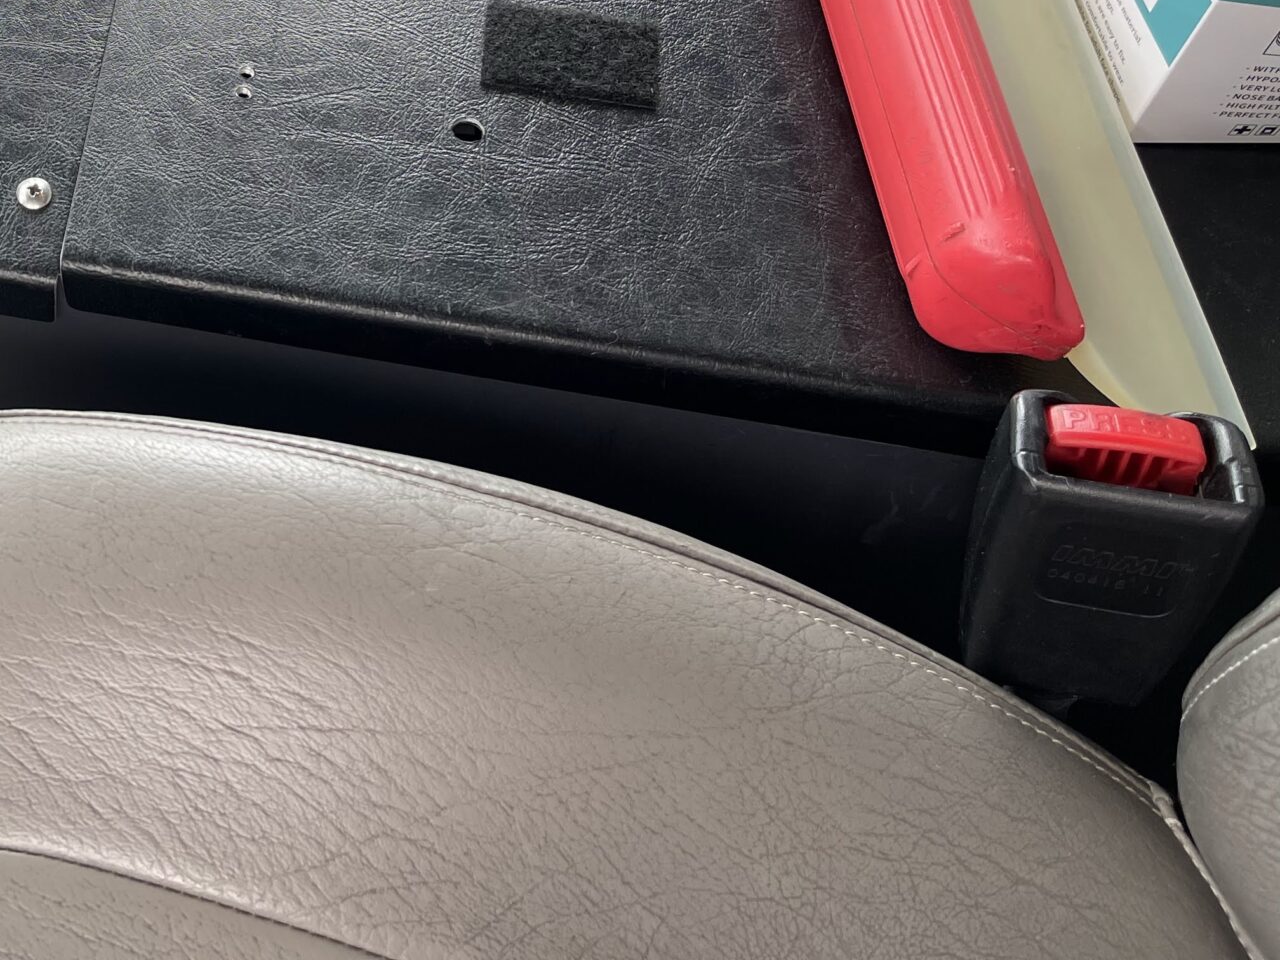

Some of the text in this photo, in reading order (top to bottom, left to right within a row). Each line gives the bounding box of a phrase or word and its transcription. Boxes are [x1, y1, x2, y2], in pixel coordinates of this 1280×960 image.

[1120, 7, 1142, 46] material.
[1246, 75, 1280, 83] HYPO
[1240, 84, 1270, 92] VERY
[1231, 93, 1266, 101] NOSE
[1225, 102, 1258, 110] HIGH
[1219, 111, 1272, 119] PERFECT
[1062, 409, 1187, 440] PRESS
